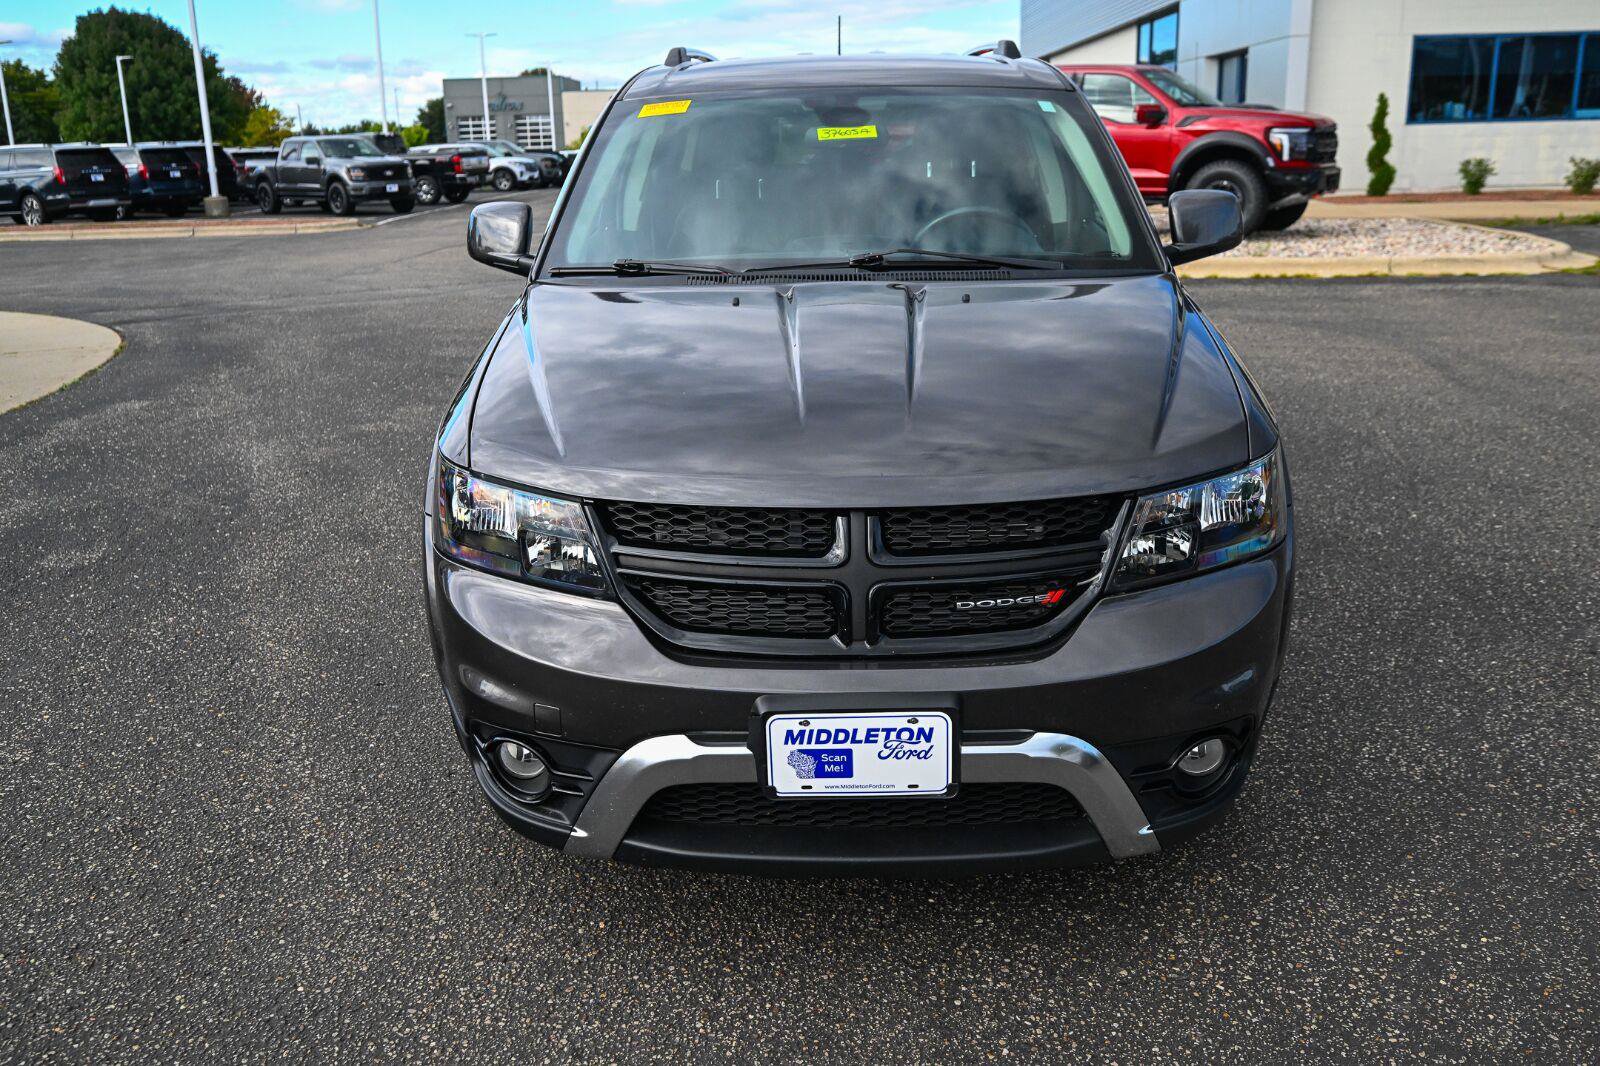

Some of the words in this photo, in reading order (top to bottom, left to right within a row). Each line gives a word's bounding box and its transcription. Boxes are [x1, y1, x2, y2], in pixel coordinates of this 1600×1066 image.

[956, 593, 1051, 609] DODGE
[783, 727, 934, 746] MIDDLETON
[821, 753, 847, 762] Scan
[878, 739, 934, 760] Ford
[824, 763, 844, 772] Me!
